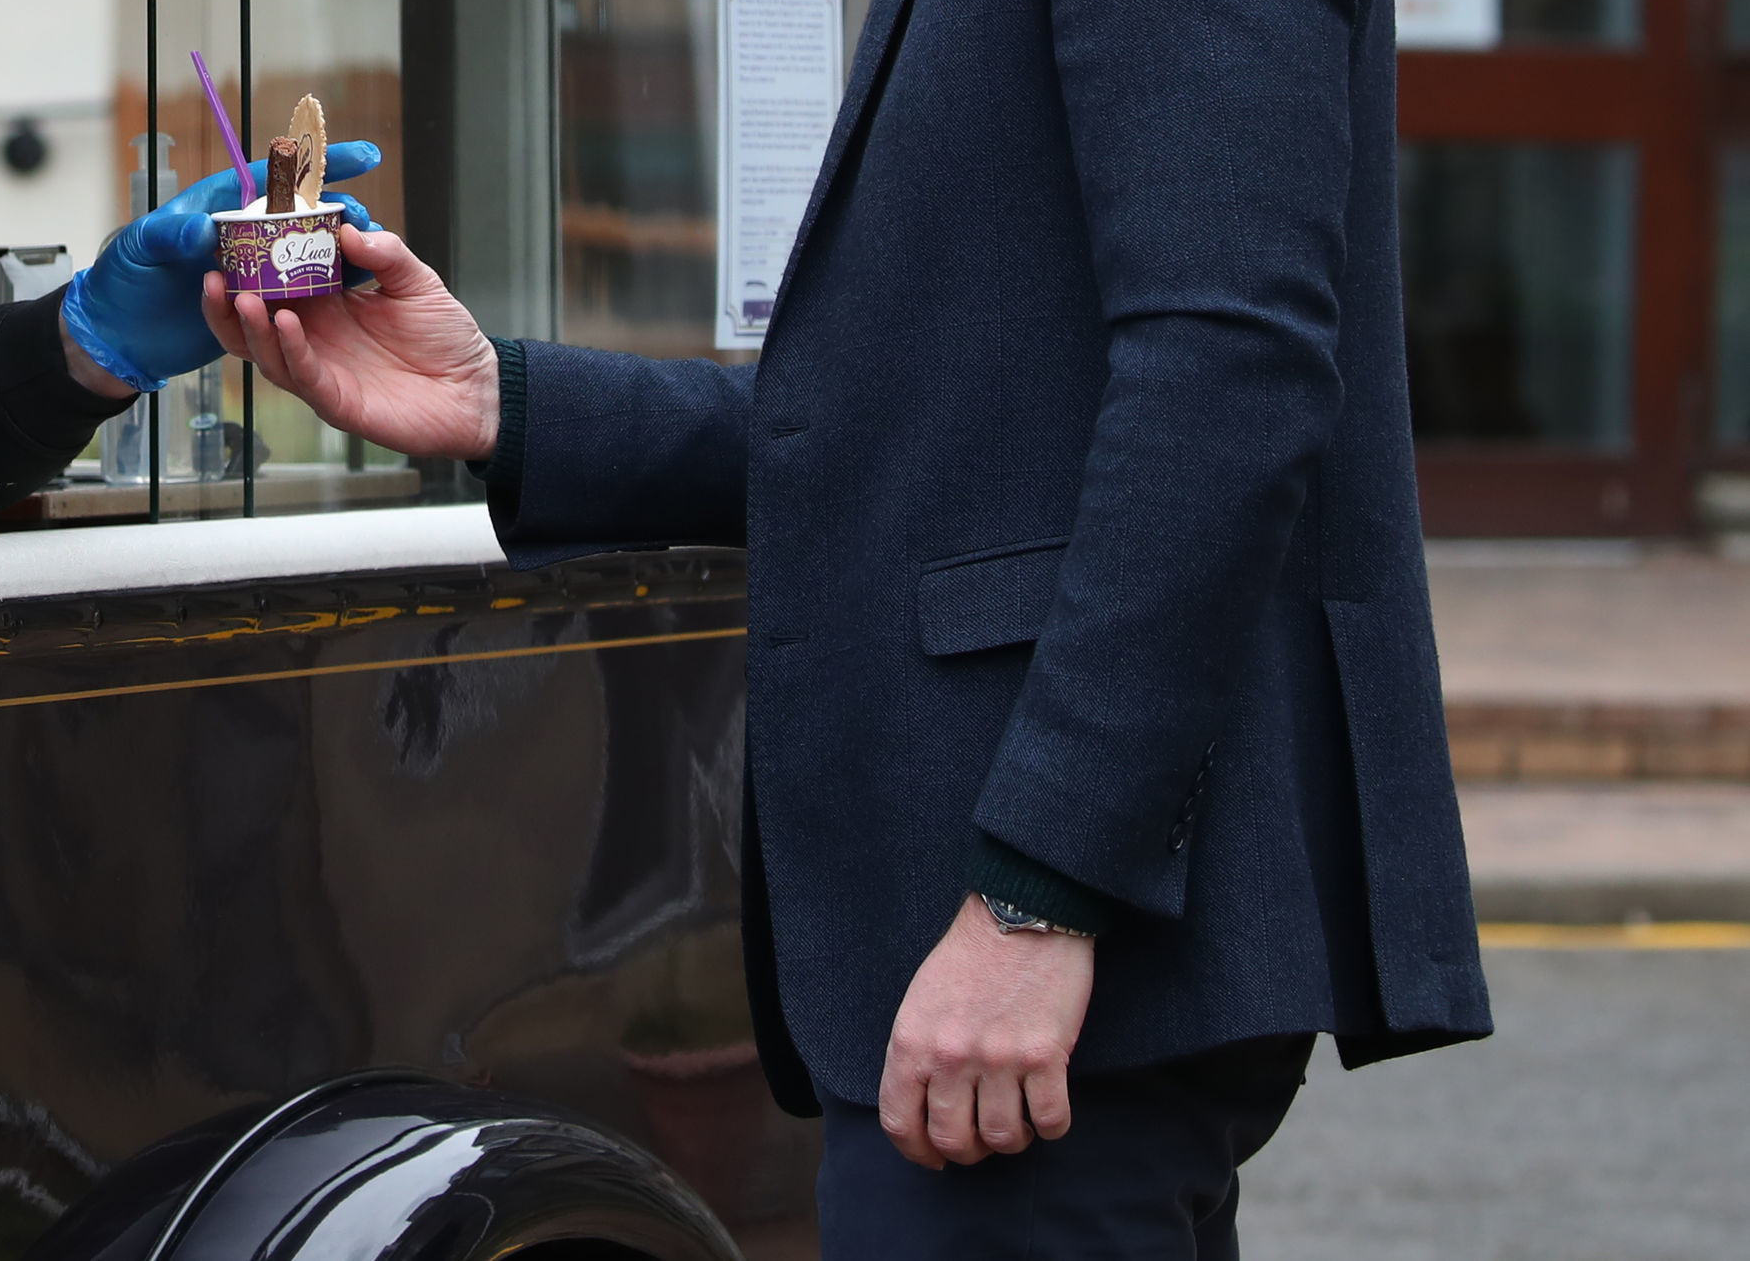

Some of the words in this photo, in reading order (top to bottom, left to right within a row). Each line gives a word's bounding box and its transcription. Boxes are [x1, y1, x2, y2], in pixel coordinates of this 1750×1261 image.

[278, 238, 333, 264] S.Luca
[289, 267, 305, 277] DAIRY
[314, 265, 328, 273] CREAM
